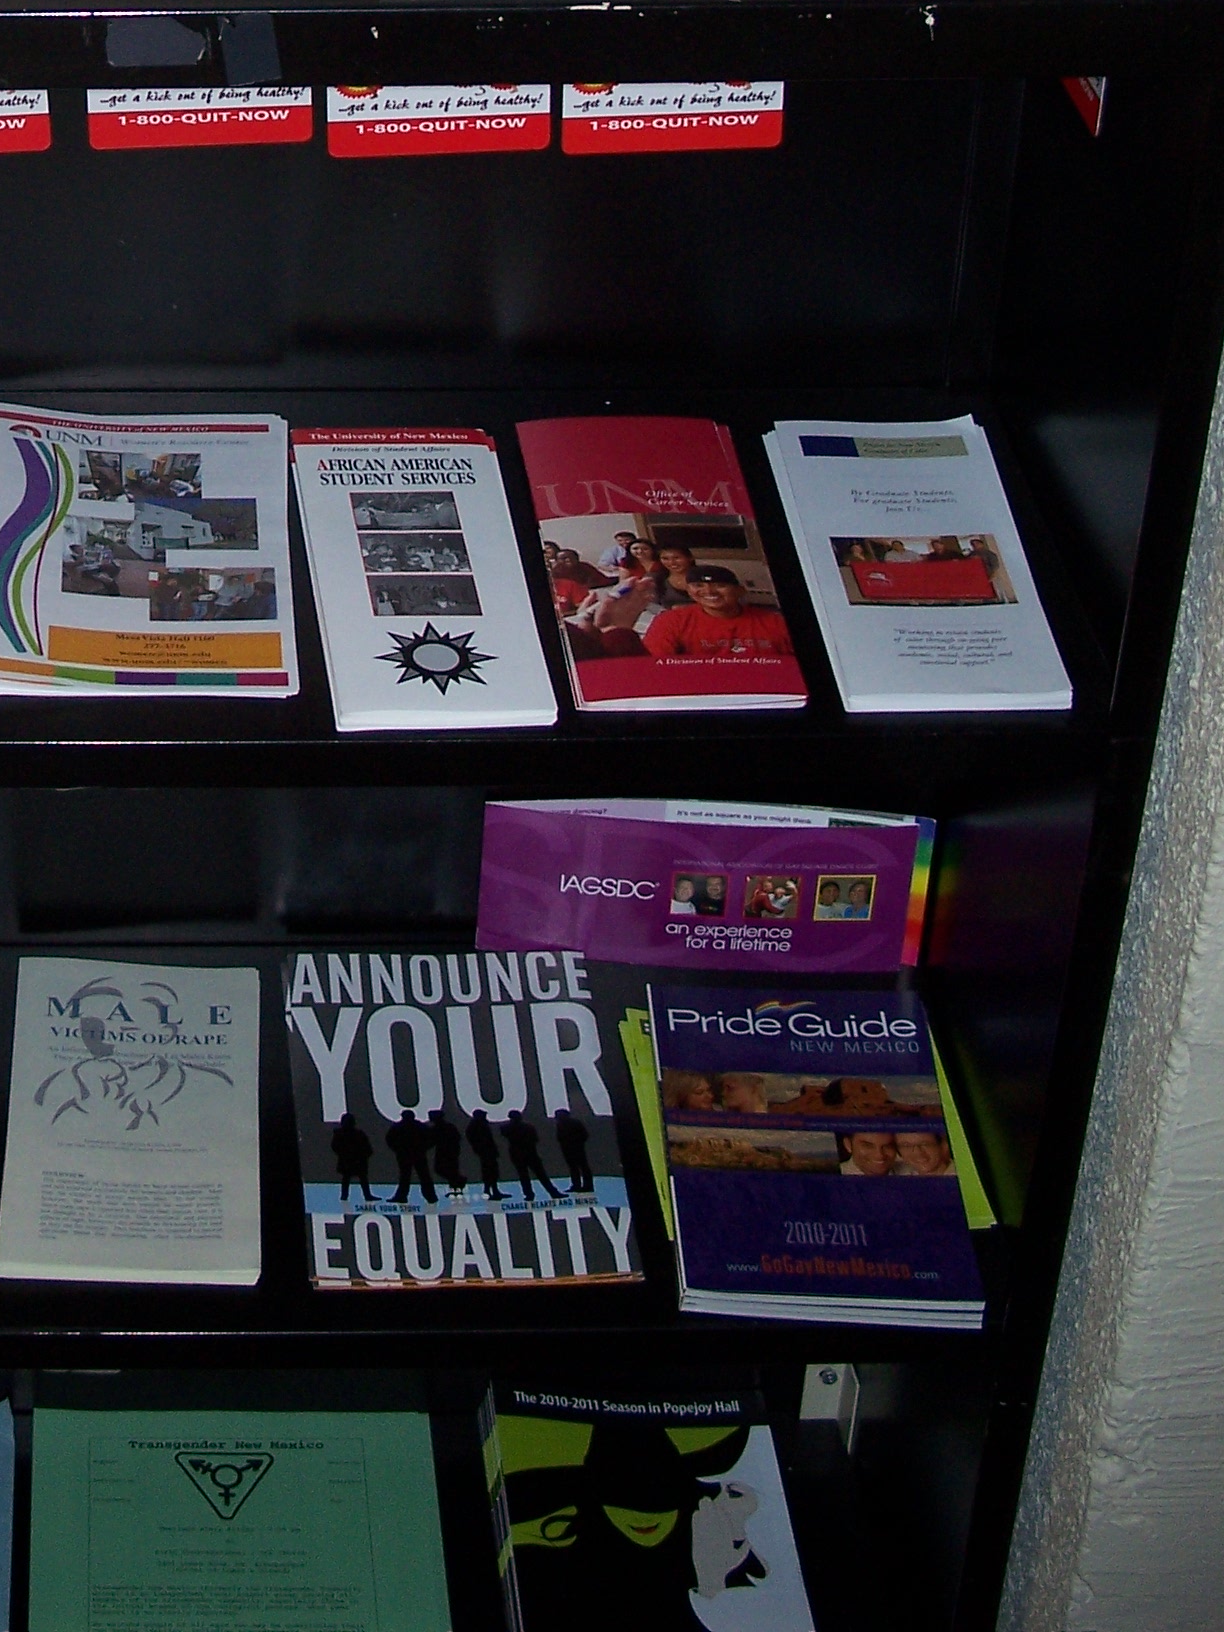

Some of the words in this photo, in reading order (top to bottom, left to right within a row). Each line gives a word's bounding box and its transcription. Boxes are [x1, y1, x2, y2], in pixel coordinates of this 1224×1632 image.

[117, 110, 289, 127] 1-800-QUIT-NOW
[355, 117, 527, 135] 1-800-QUIT-NOW
[589, 114, 759, 131] 1-800-QUIT-NOW
[43, 429, 104, 447] UNM
[317, 457, 386, 471] AFRICAN
[390, 457, 473, 471] AMERICAN
[319, 472, 399, 486] STUDENT
[401, 471, 477, 485] SERVICES
[665, 923, 691, 935] an
[694, 924, 793, 940] experience
[685, 935, 709, 949] for
[713, 939, 726, 949] a
[730, 935, 791, 952] lifetime
[291, 951, 593, 1009] ANNOUNCE
[667, 1008, 781, 1036] Pride
[788, 1011, 917, 1038] Guide
[790, 1039, 835, 1053] NEW
[844, 1040, 920, 1053] MEXICO
[289, 1002, 614, 1123] YOUR
[783, 1220, 868, 1247] 2010-2011
[312, 1207, 633, 1279] EQUALITY
[513, 1390, 537, 1404] The
[539, 1393, 599, 1411] 2010-2011
[602, 1400, 647, 1414] Season
[648, 1402, 661, 1414] in
[663, 1402, 713, 1416] Popejoy
[715, 1400, 741, 1413] Hall
